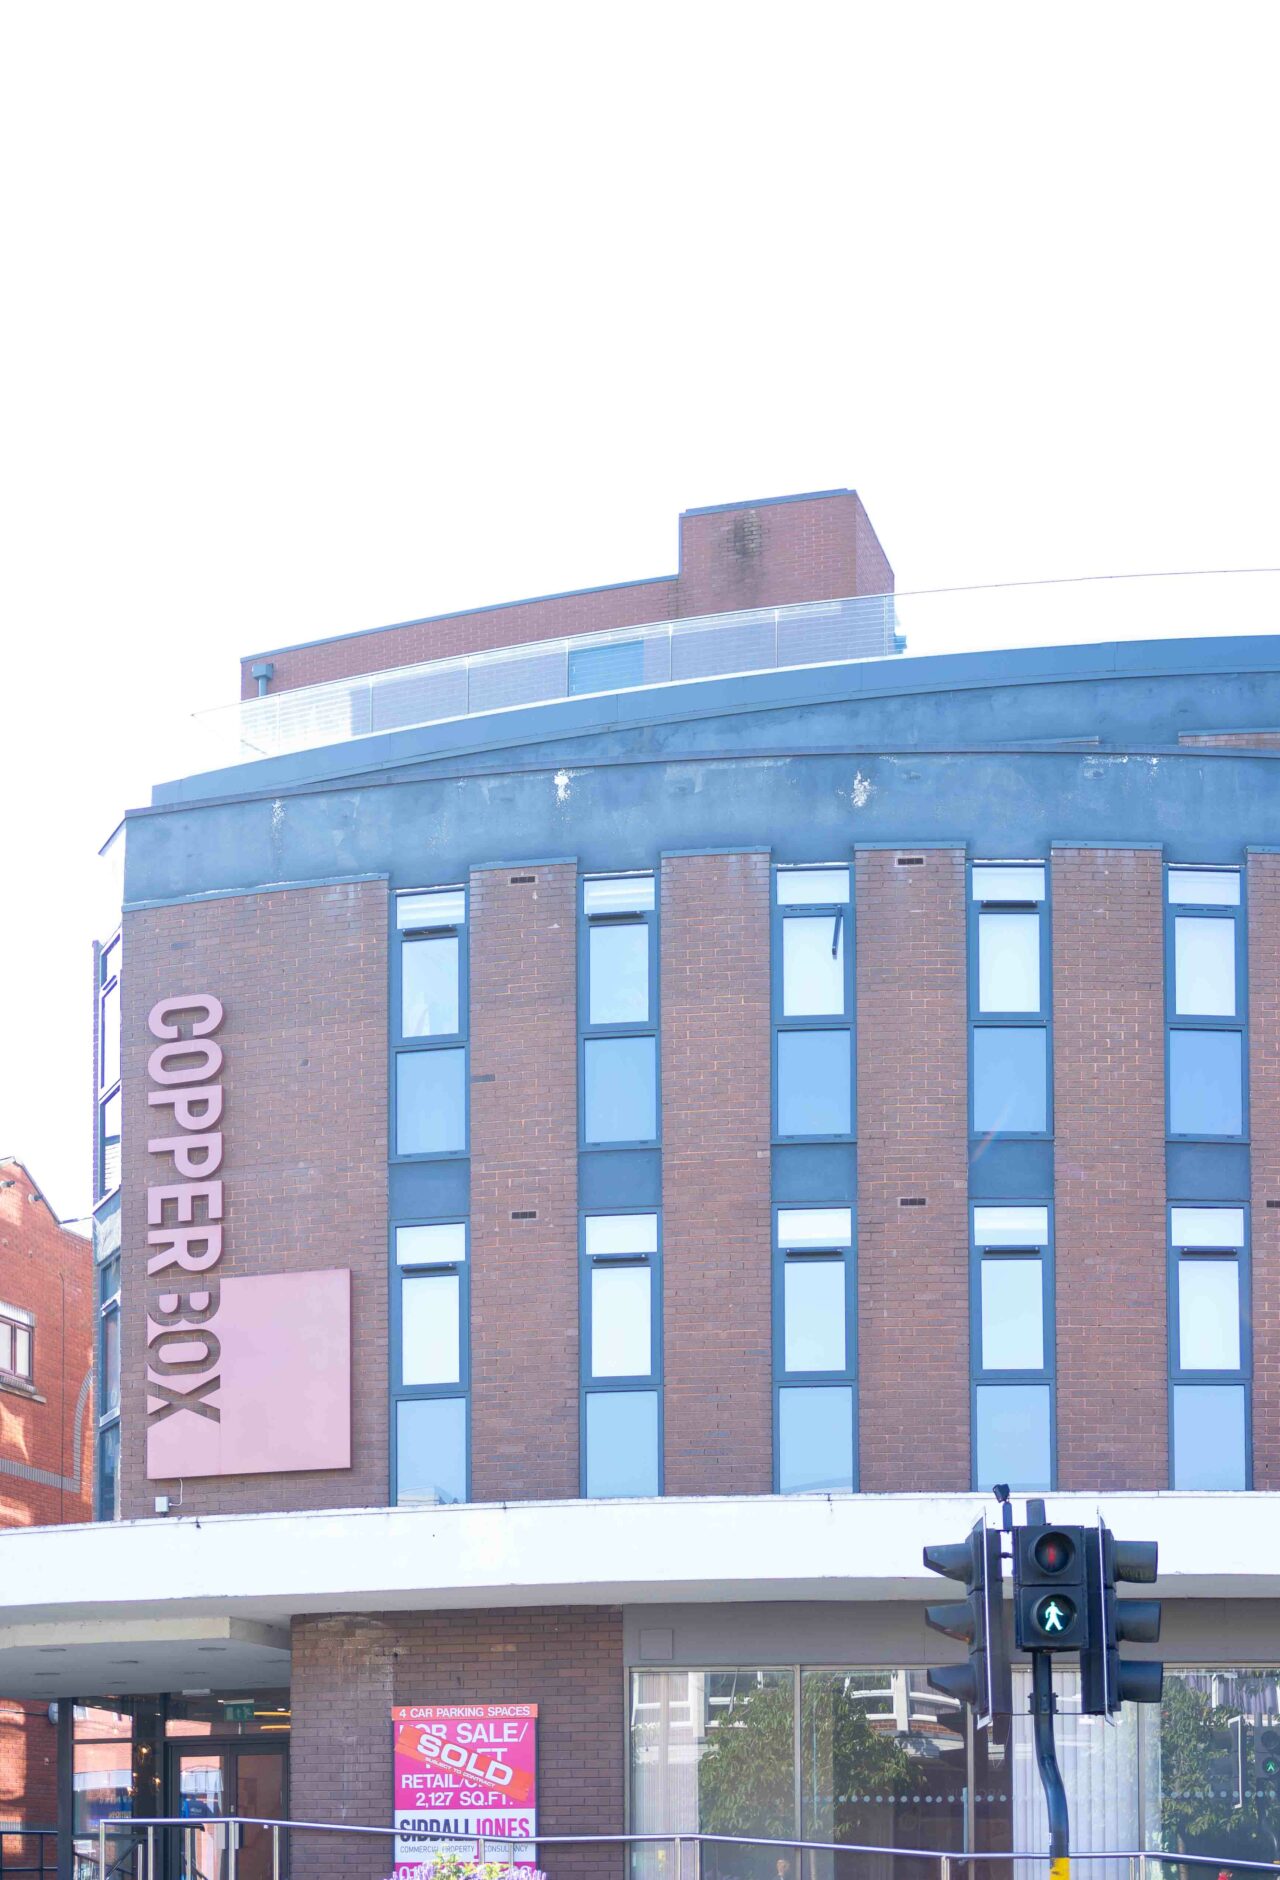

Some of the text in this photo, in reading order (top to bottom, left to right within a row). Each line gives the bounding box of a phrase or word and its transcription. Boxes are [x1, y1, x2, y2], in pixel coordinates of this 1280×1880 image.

[147, 993, 225, 1428] COPPER BOX
[399, 1706, 531, 1719] 4 CAR PARKING SPACES
[456, 1722, 529, 1743] SALE/
[416, 1733, 513, 1786] SOLD
[416, 1791, 454, 1807] 2,127
[484, 1844, 528, 1853] CONSULANCY
